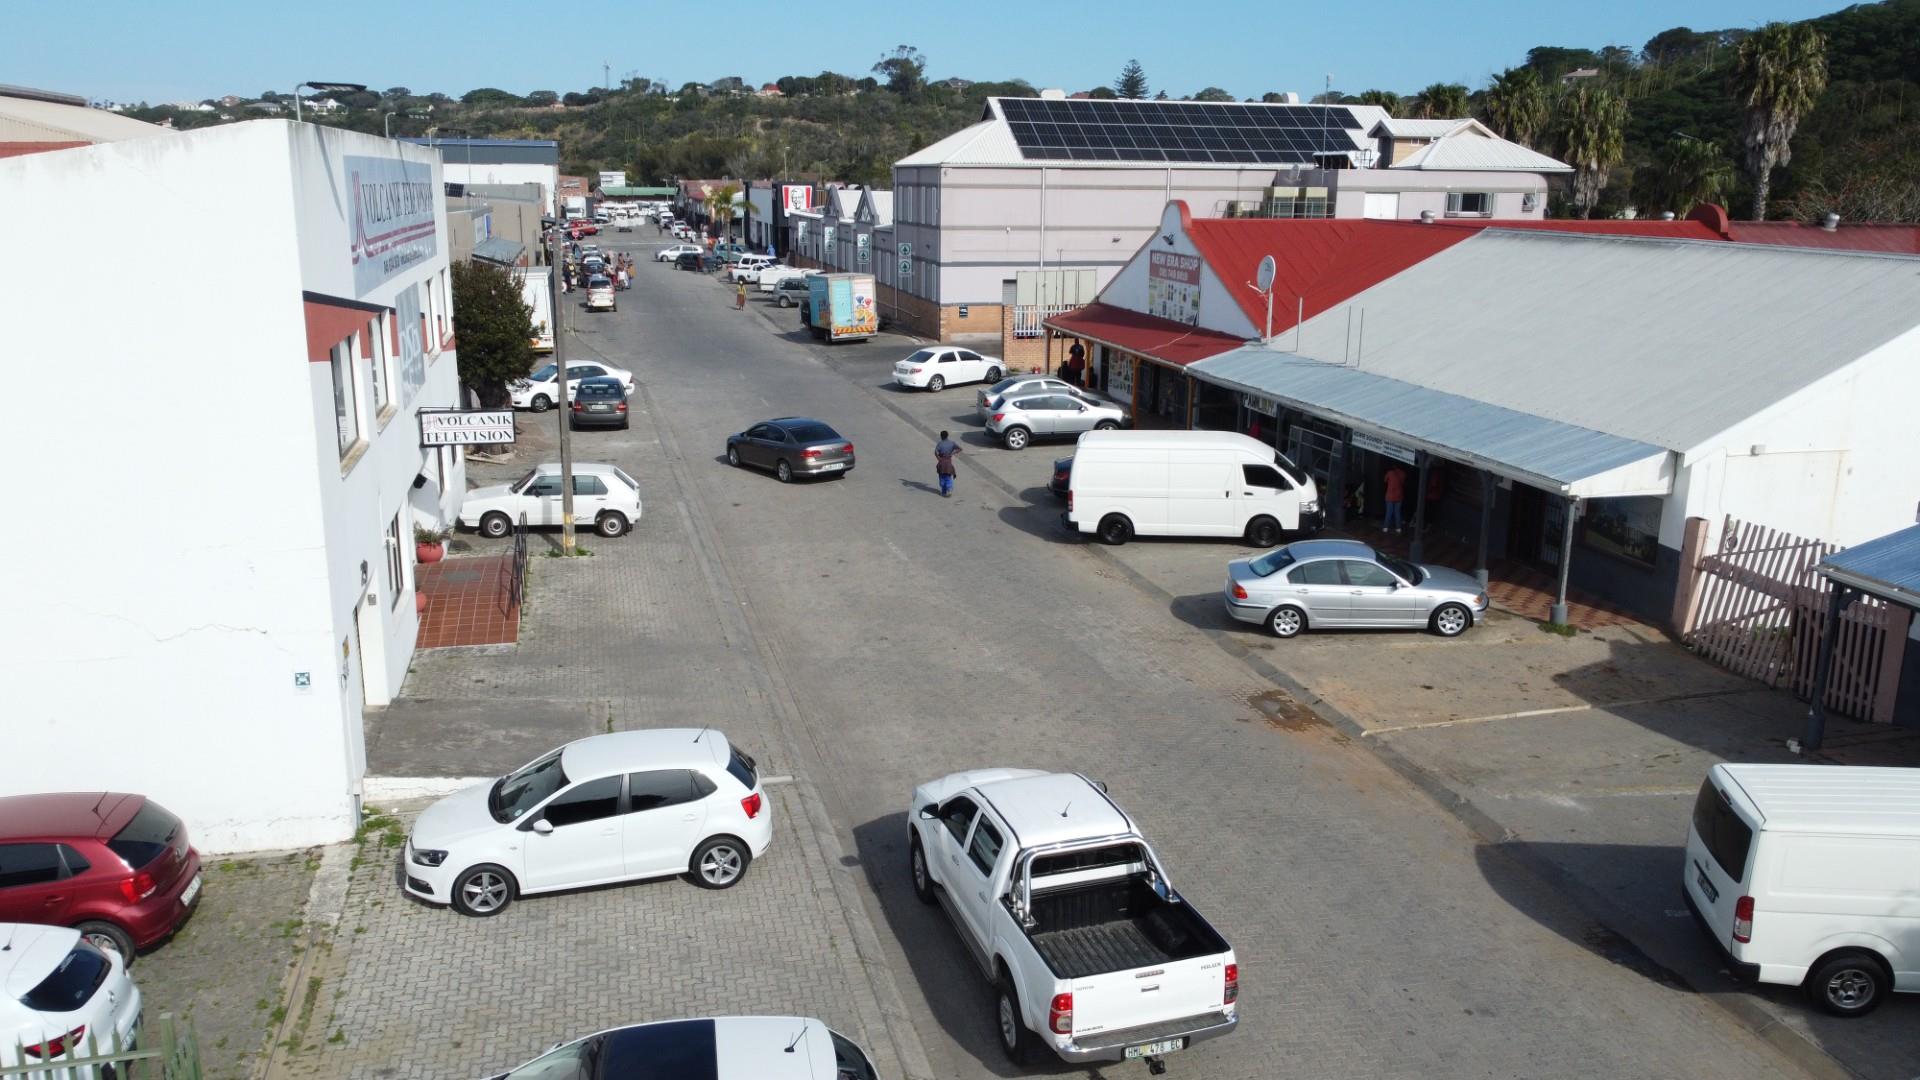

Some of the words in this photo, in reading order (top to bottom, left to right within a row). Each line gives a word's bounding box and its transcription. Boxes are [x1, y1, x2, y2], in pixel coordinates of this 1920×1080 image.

[1152, 253, 1166, 265] NEW
[1167, 255, 1179, 267] ERA
[1180, 256, 1198, 271] SHOP
[437, 415, 512, 426] VOLCANIK
[423, 430, 512, 443] TELEVISION
